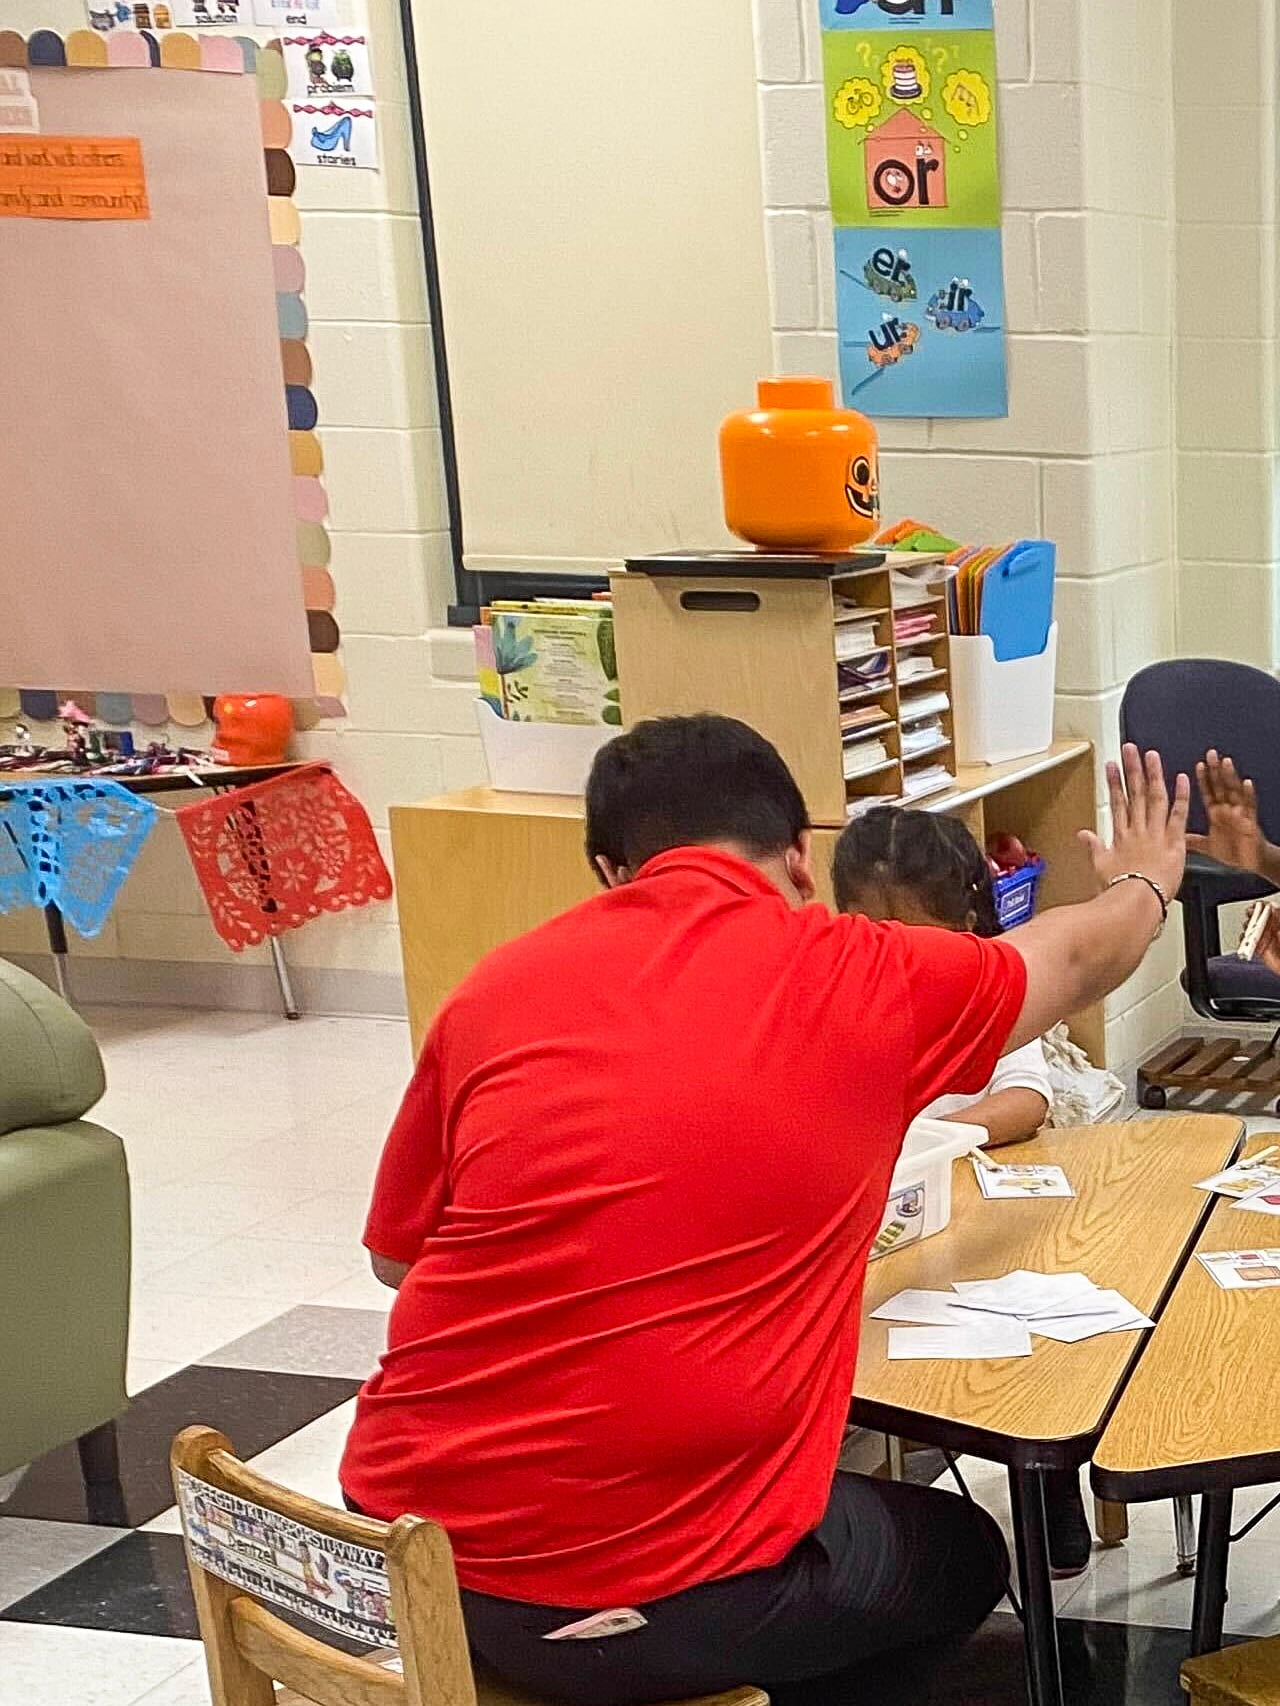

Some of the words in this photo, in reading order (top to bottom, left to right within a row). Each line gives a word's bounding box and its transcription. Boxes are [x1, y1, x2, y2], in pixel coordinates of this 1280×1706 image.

[195, 13, 238, 25] solution
[285, 14, 307, 25] end
[306, 83, 356, 95] problem
[315, 153, 357, 166] stories
[873, 156, 940, 206] or
[872, 246, 913, 283] er
